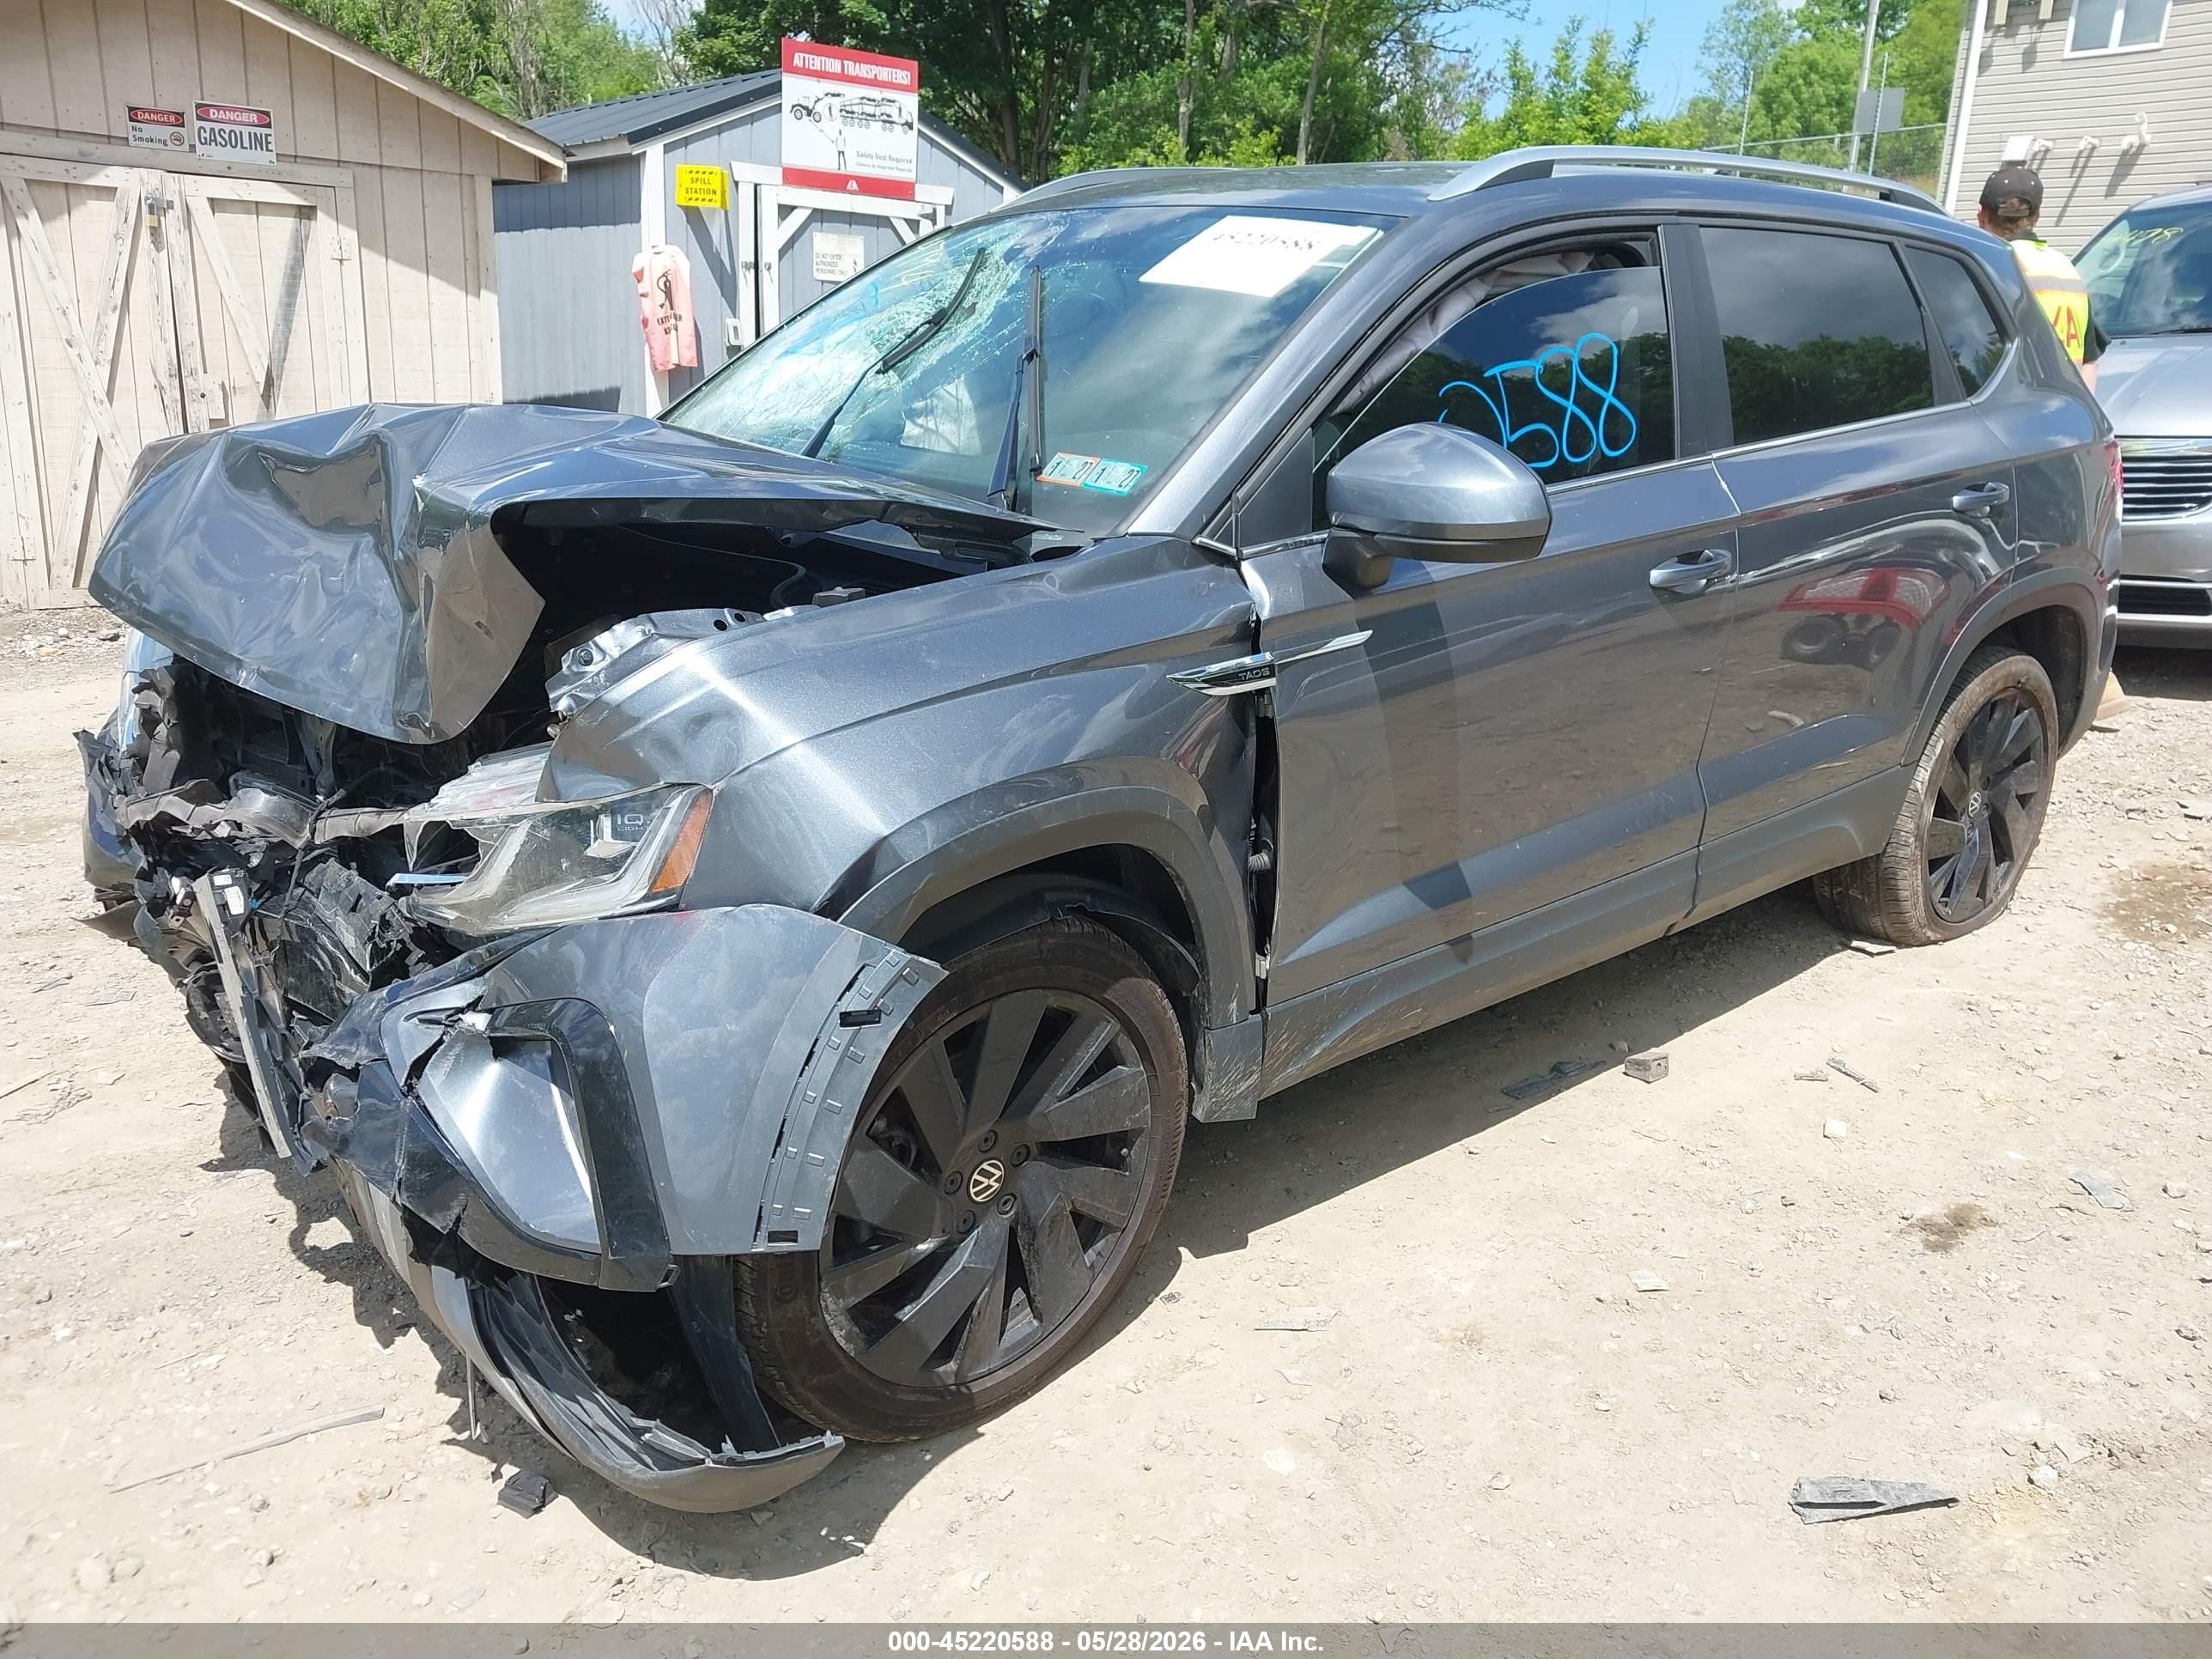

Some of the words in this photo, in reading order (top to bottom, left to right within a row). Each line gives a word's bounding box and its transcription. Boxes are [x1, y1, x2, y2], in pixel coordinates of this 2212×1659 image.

[793, 52, 842, 75] ATTENTION
[843, 60, 911, 85] TRANSPORTERS!
[137, 111, 176, 123] DANGER
[209, 108, 258, 123] DANGER
[131, 125, 143, 133] No
[132, 134, 168, 147] Smoking
[197, 125, 274, 153] GASOLINE
[856, 150, 874, 161] Safety
[690, 177, 712, 185] SPILL
[684, 187, 717, 197] STATION
[1072, 460, 1094, 481] 27
[1118, 468, 1141, 489] 27
[1237, 667, 1271, 681] TAOS
